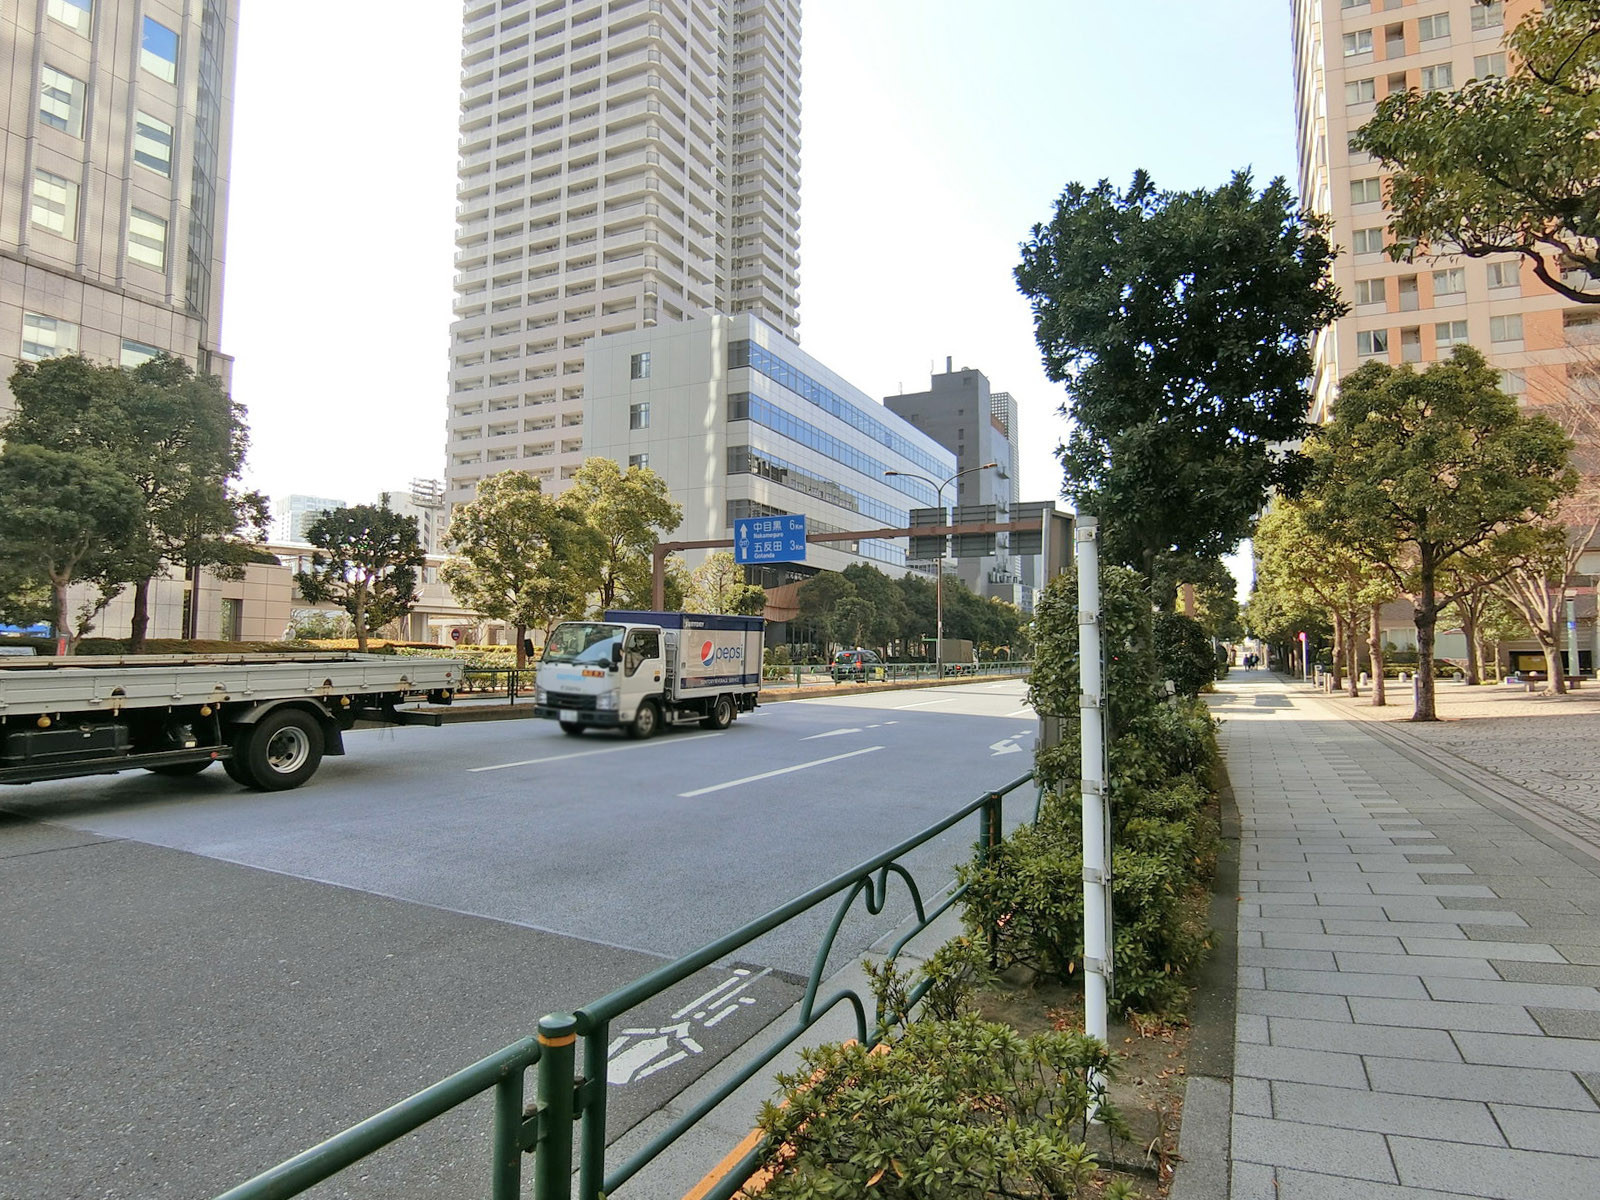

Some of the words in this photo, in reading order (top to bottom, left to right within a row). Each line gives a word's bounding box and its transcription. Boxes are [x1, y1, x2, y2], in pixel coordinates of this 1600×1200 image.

[754, 520, 782, 532] 中目黒
[754, 541, 782, 552] 五反田
[716, 644, 743, 663] pepsi
